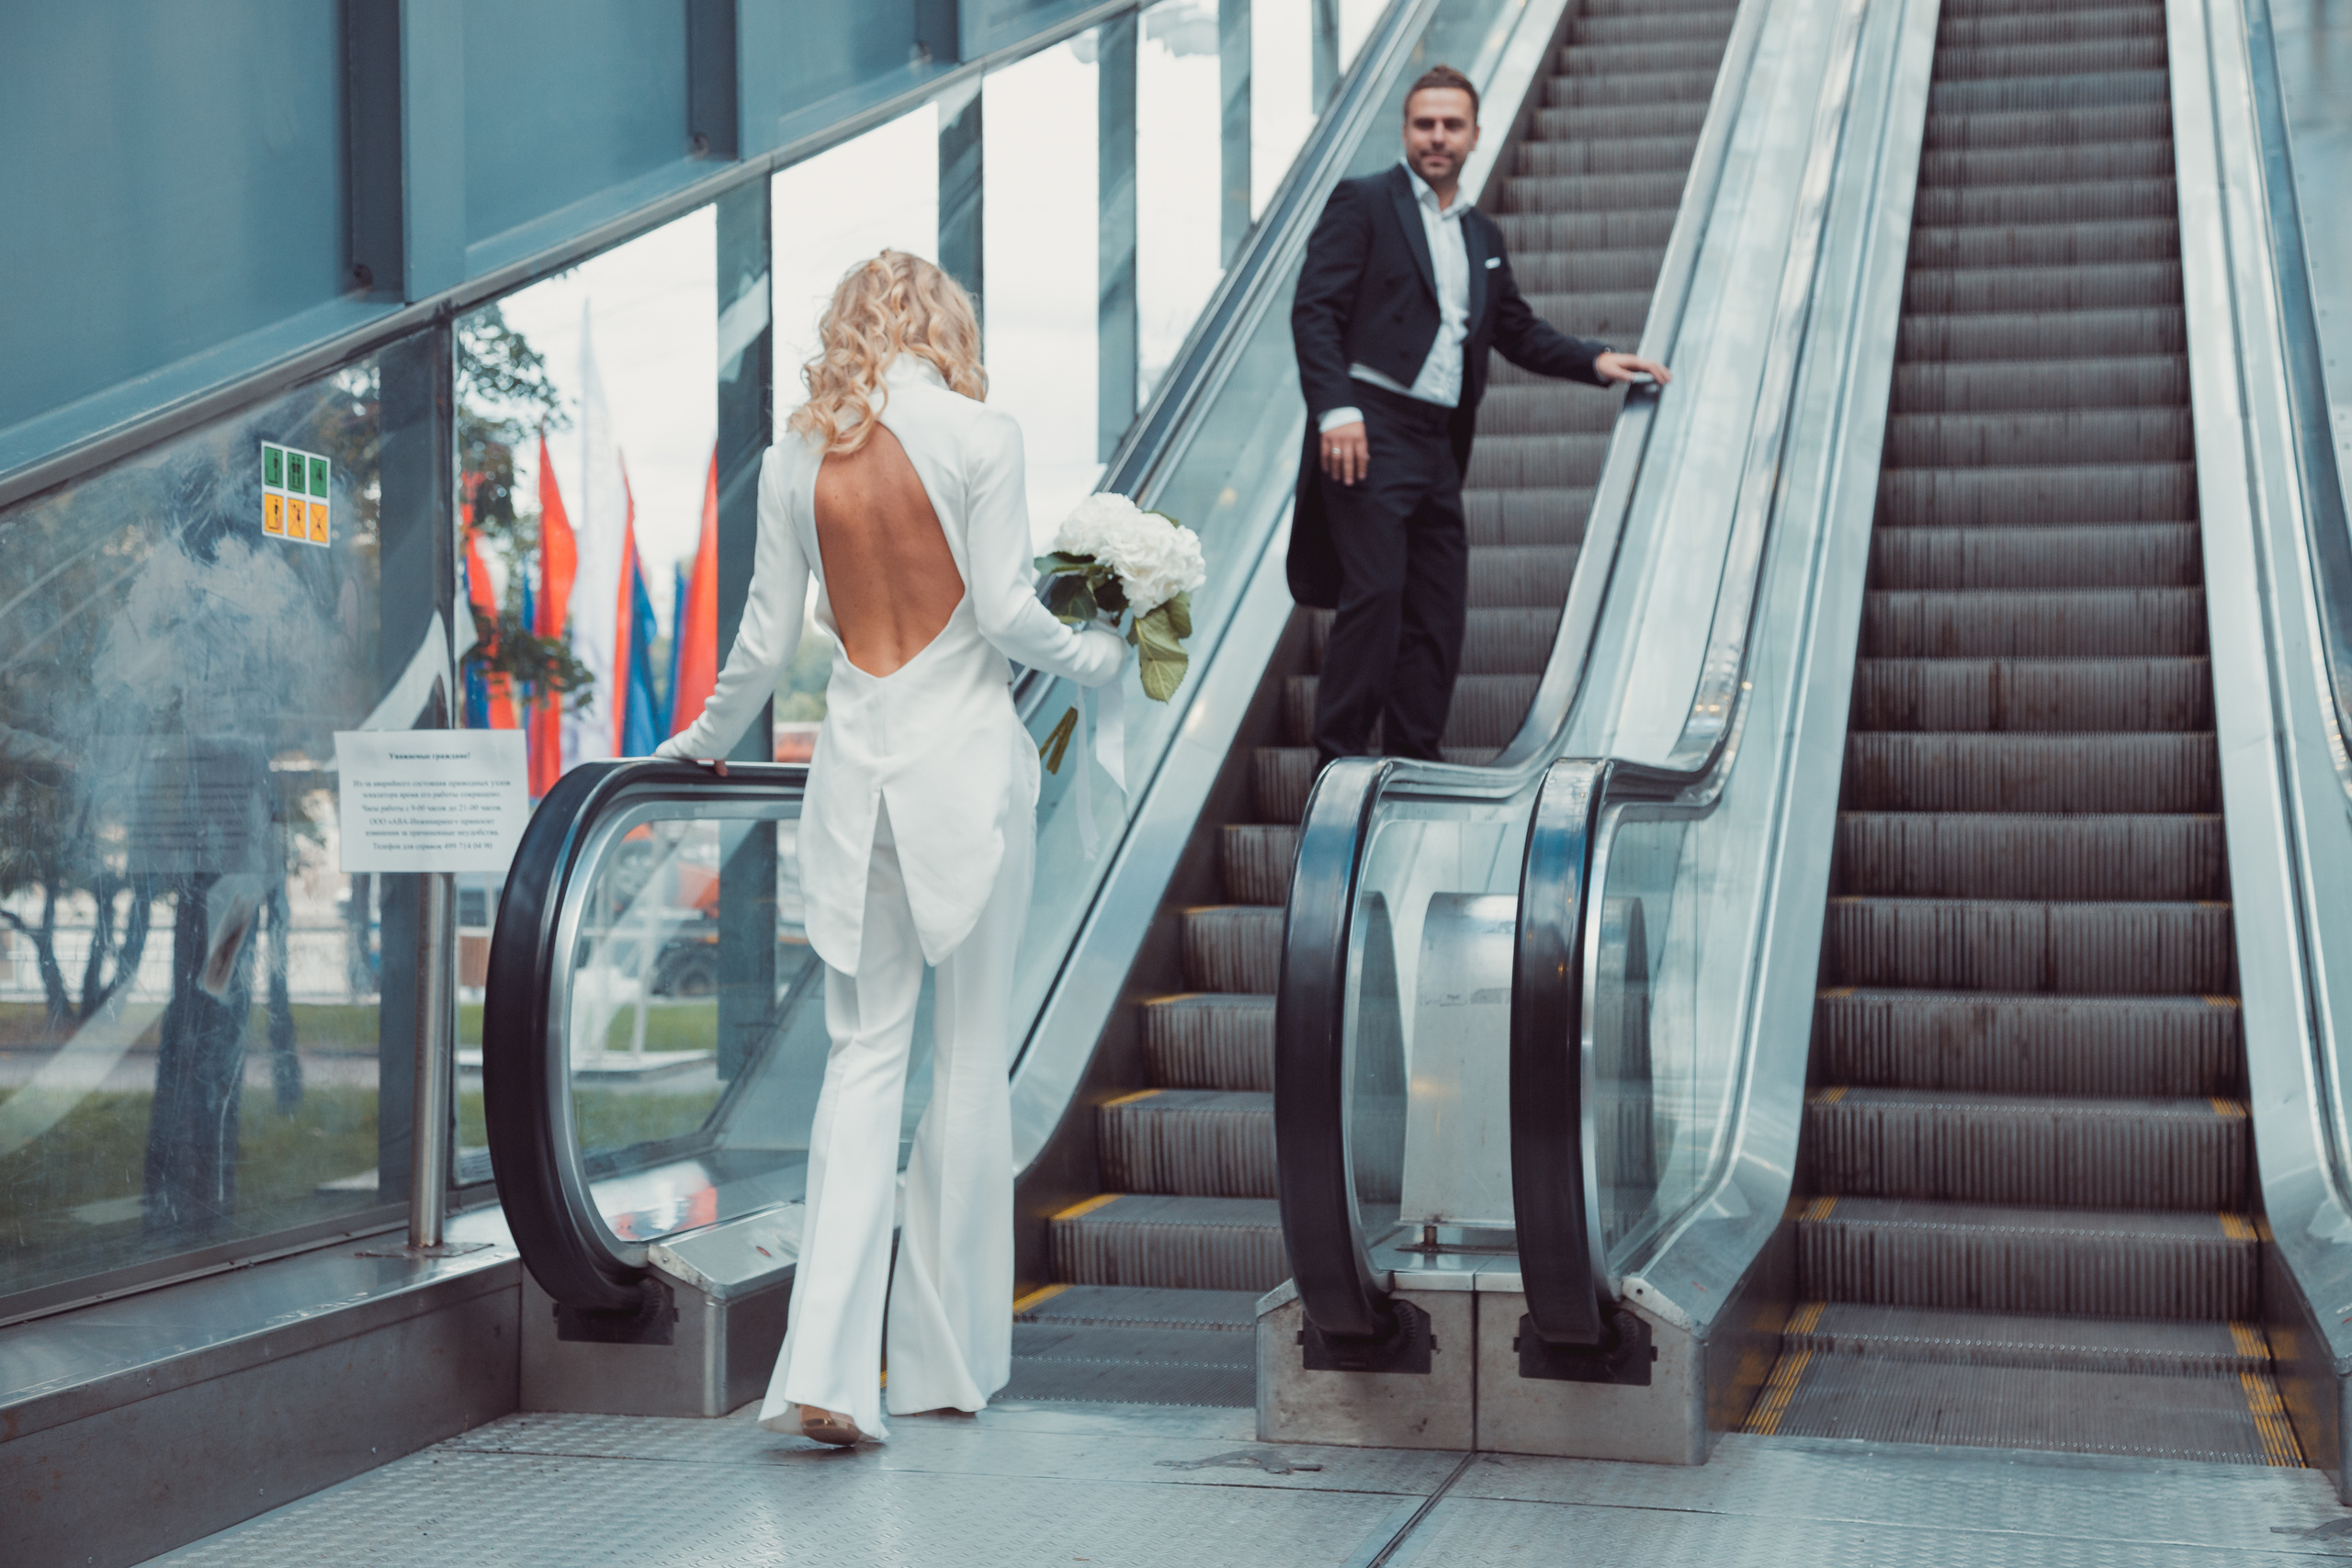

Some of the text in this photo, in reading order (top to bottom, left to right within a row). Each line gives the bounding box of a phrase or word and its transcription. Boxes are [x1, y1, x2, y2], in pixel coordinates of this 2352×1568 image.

[389, 751, 470, 761] Уважаемые граждане!
[373, 779, 411, 788] аварийного
[448, 780, 489, 788] приводных
[433, 790, 458, 799] работы
[361, 804, 379, 812] Часы
[380, 804, 404, 814] работы
[373, 841, 401, 851] Телефон
